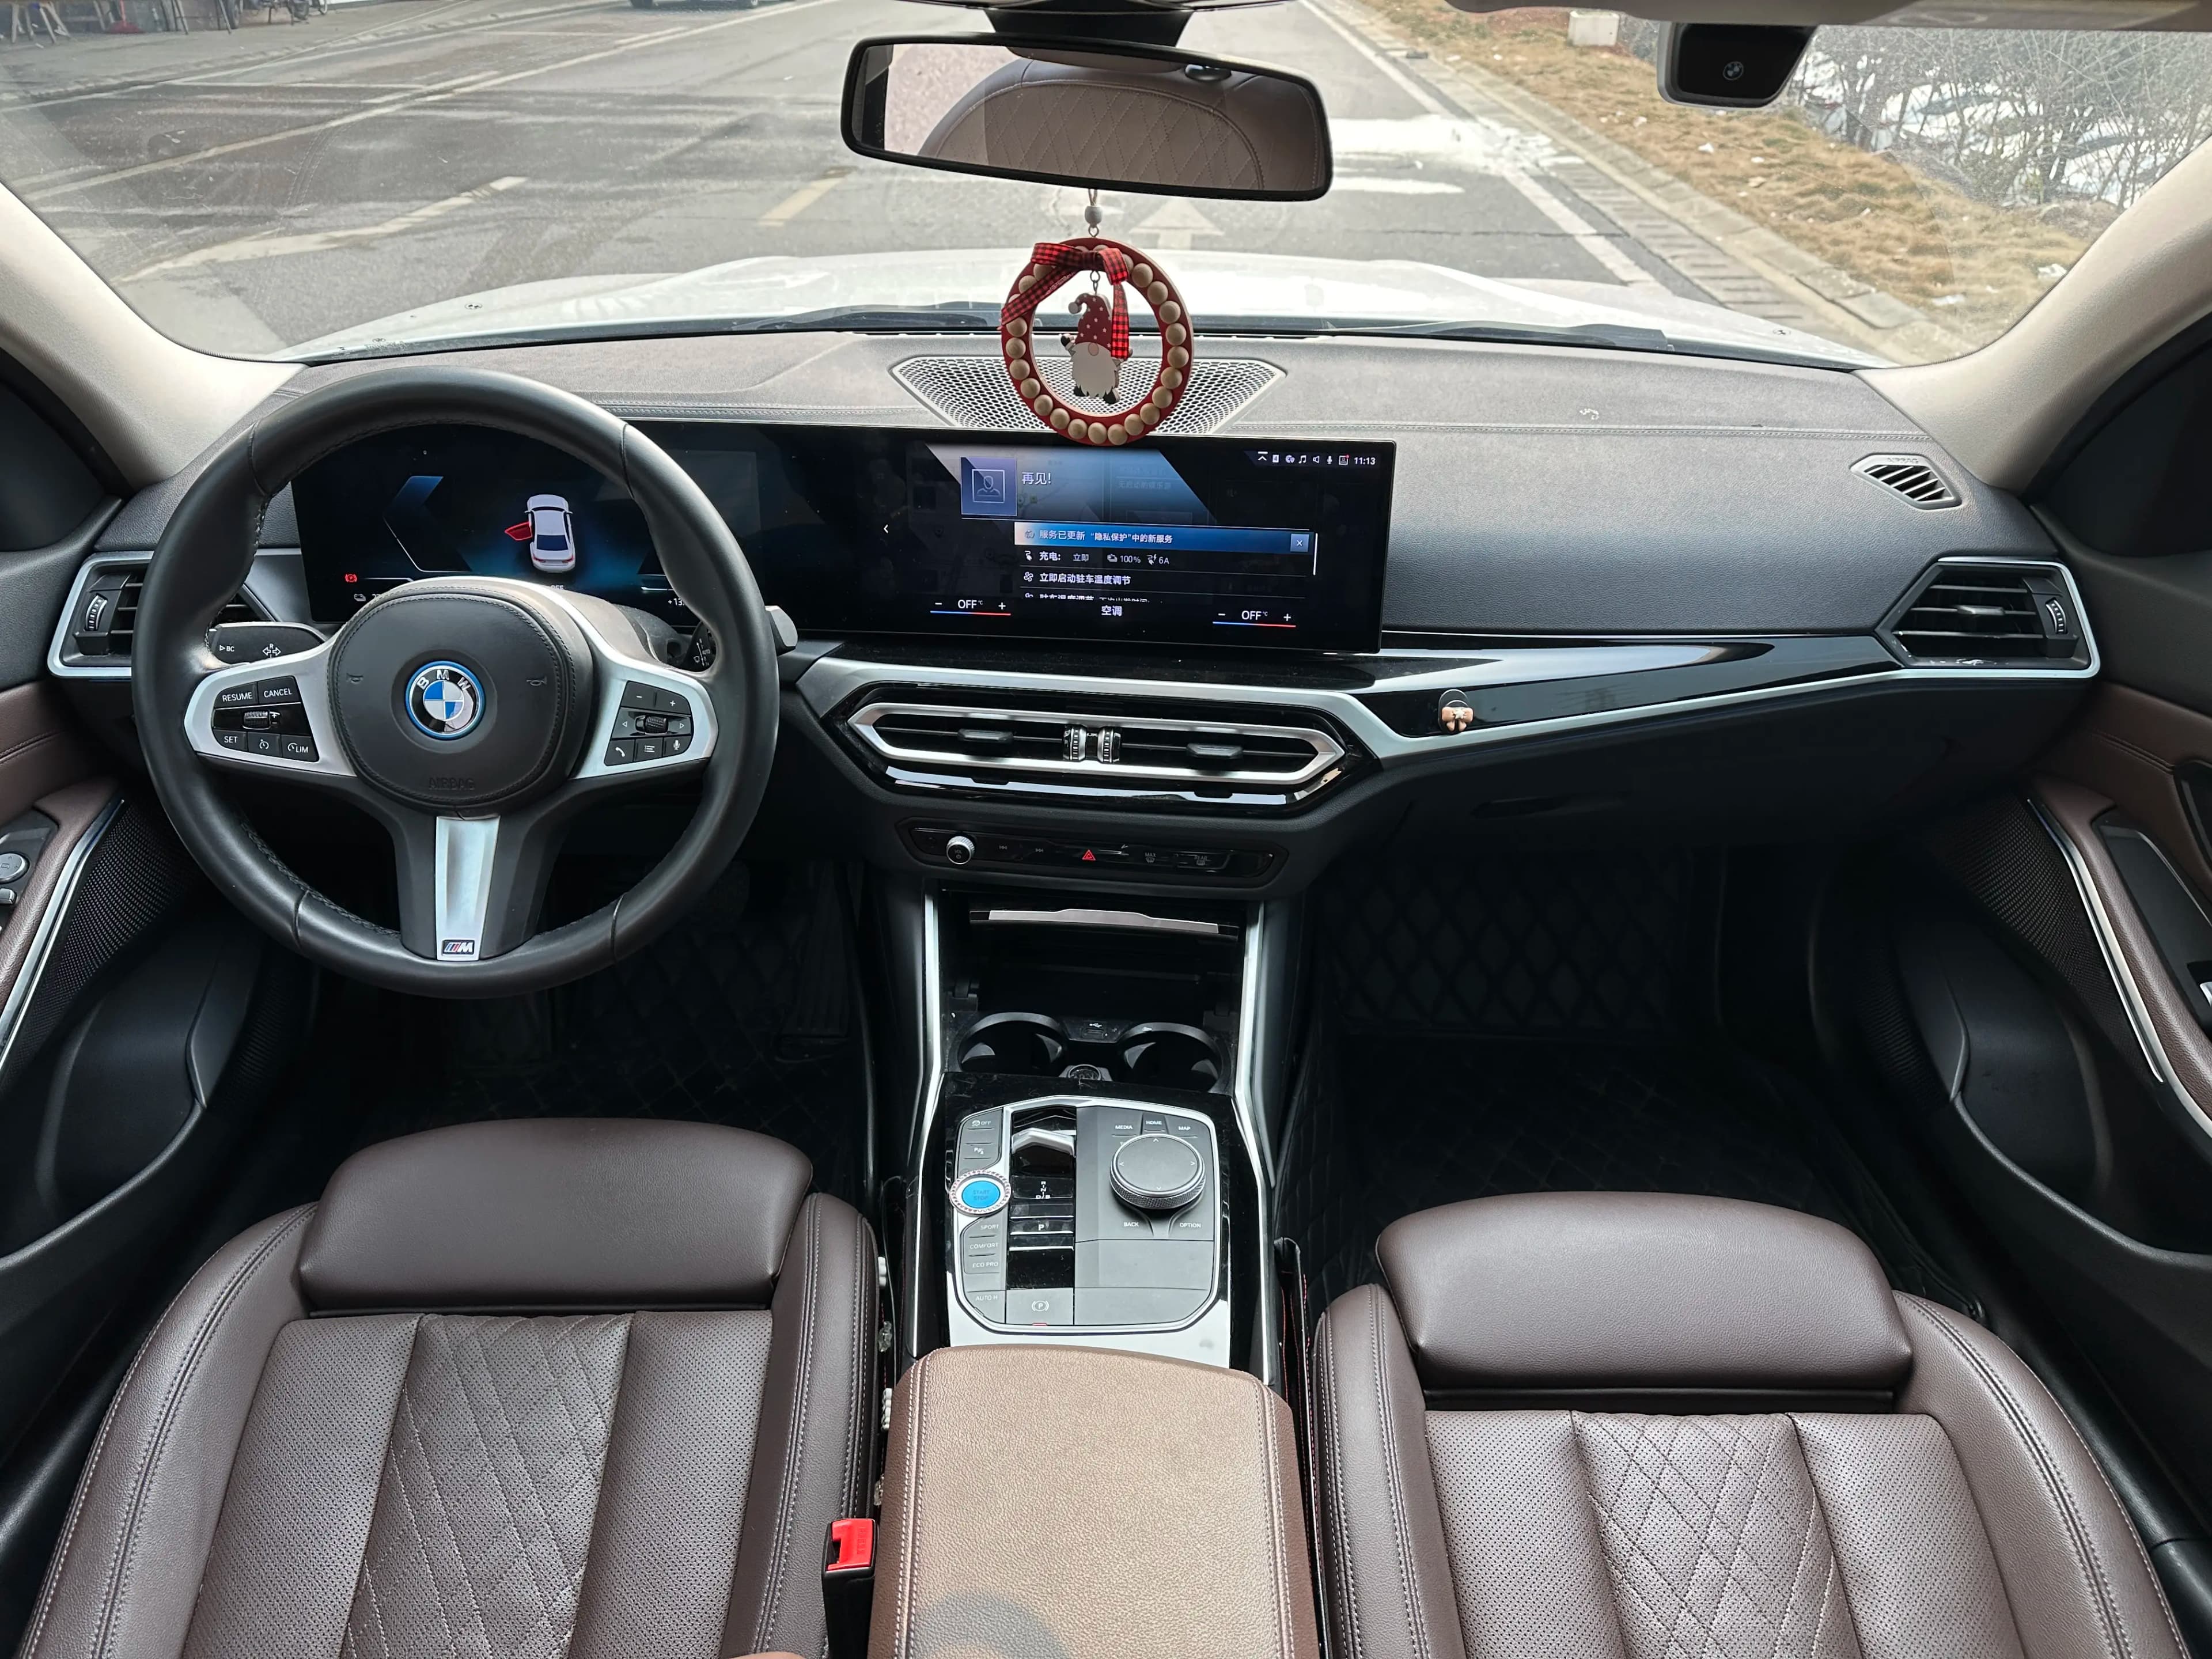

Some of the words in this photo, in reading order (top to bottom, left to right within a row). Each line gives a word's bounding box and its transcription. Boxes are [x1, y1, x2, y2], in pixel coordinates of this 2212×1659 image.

[1354, 457, 1376, 465] 11:13
[1039, 529, 1086, 540] 服务已更新
[1073, 553, 1089, 562] 立即
[1120, 555, 1141, 563] 100%
[1158, 556, 1170, 565] 6A
[1039, 573, 1131, 585] 立即启动驻车温度调节
[957, 599, 978, 609] OFF
[1101, 605, 1122, 616] 空调
[1241, 610, 1262, 620] OFF
[416, 669, 471, 691] BMW
[222, 692, 253, 702] RESUME
[263, 688, 293, 698] CANCEL
[224, 736, 238, 744] SET
[295, 745, 309, 753] LIM
[429, 777, 475, 790] AIRBAG
